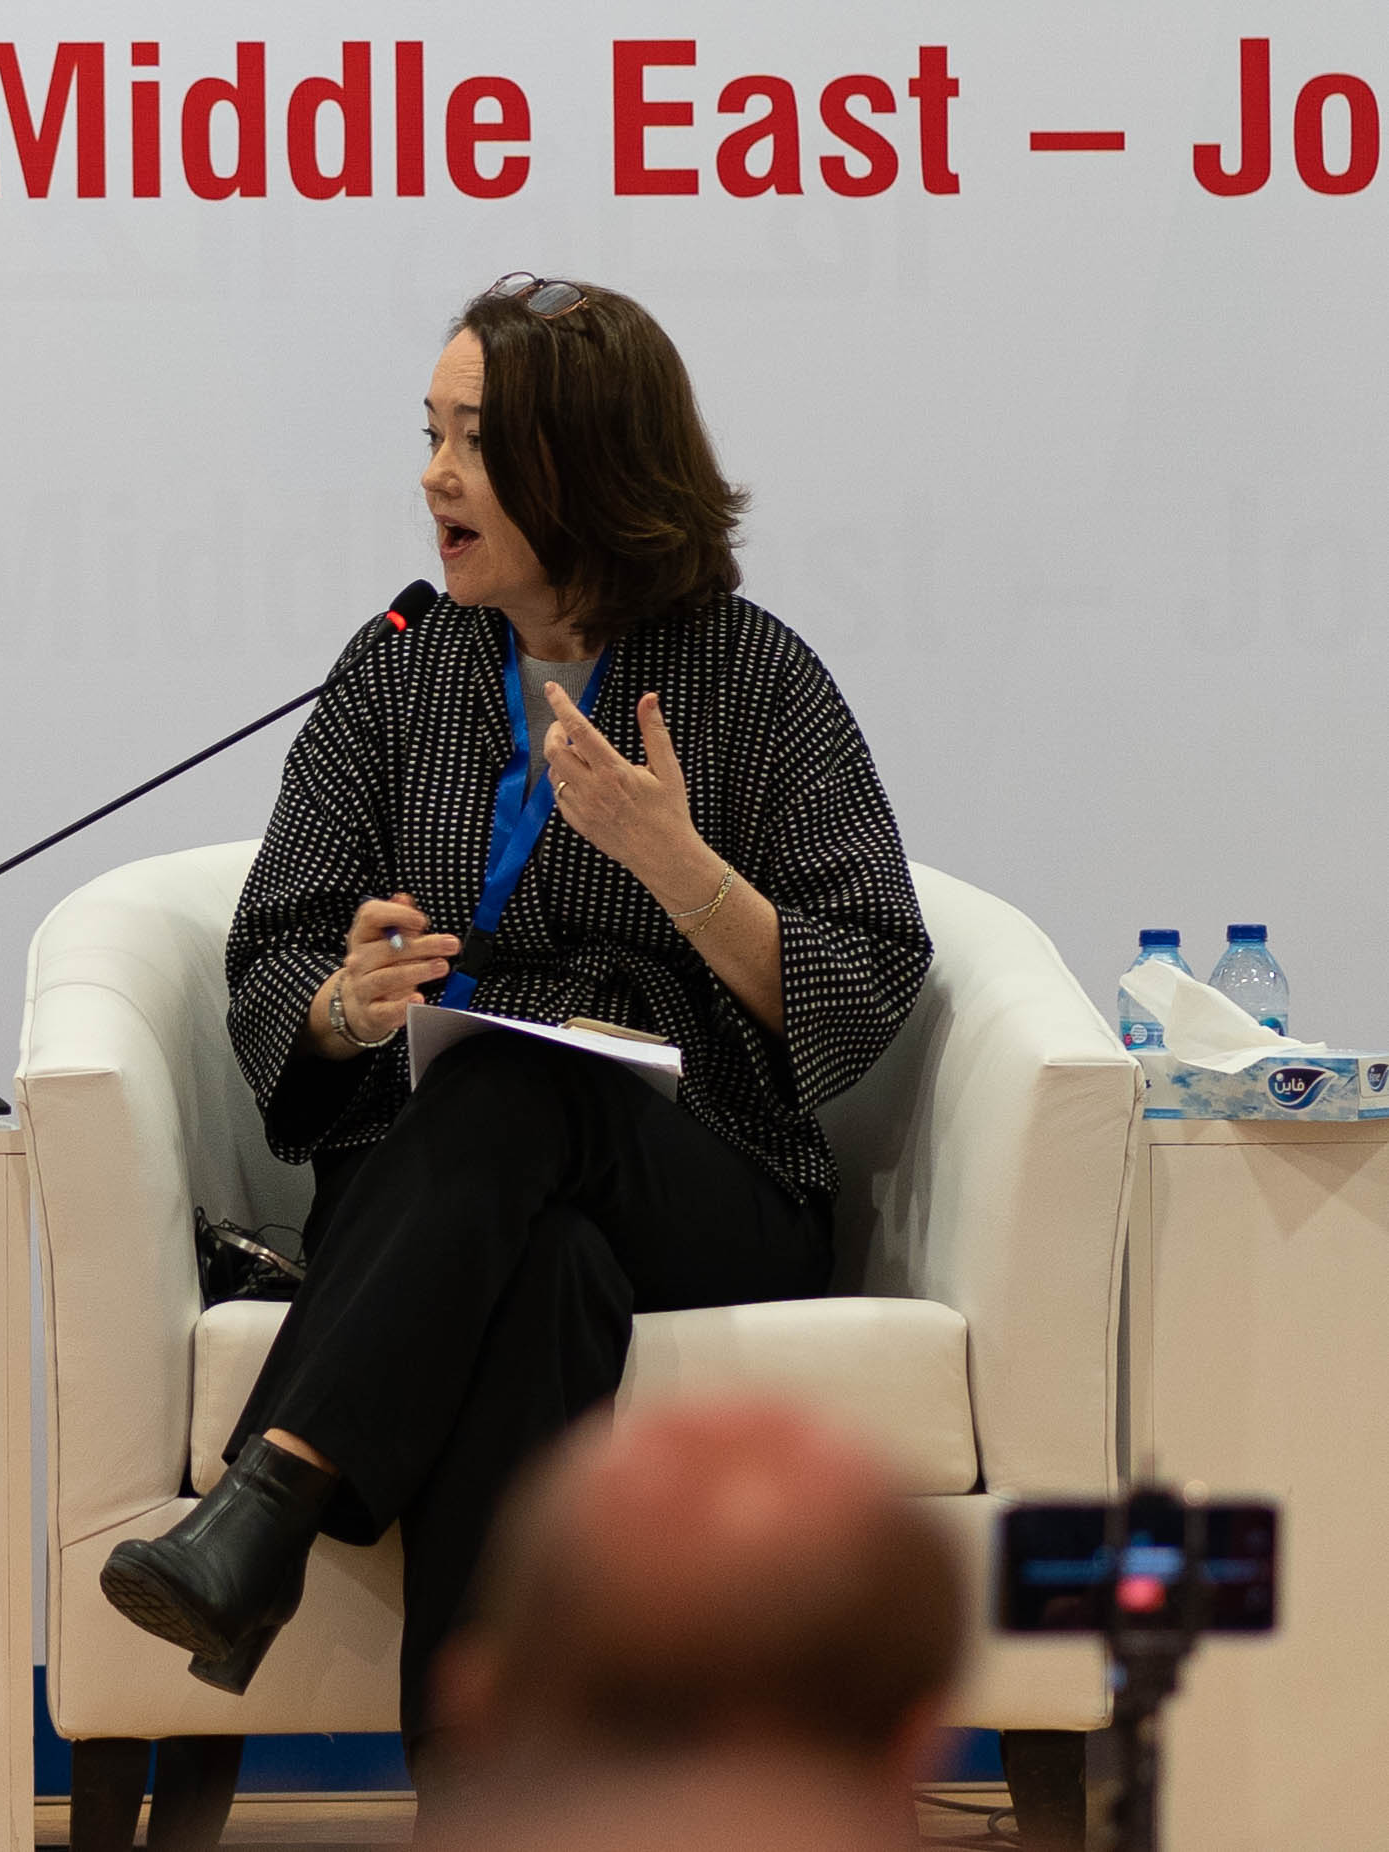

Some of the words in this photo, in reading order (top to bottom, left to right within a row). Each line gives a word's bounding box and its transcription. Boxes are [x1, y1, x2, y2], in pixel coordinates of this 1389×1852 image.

[612, 39, 960, 198] East
[1193, 37, 1380, 197] Jo
[1274, 1072, 1305, 1094] فاين
